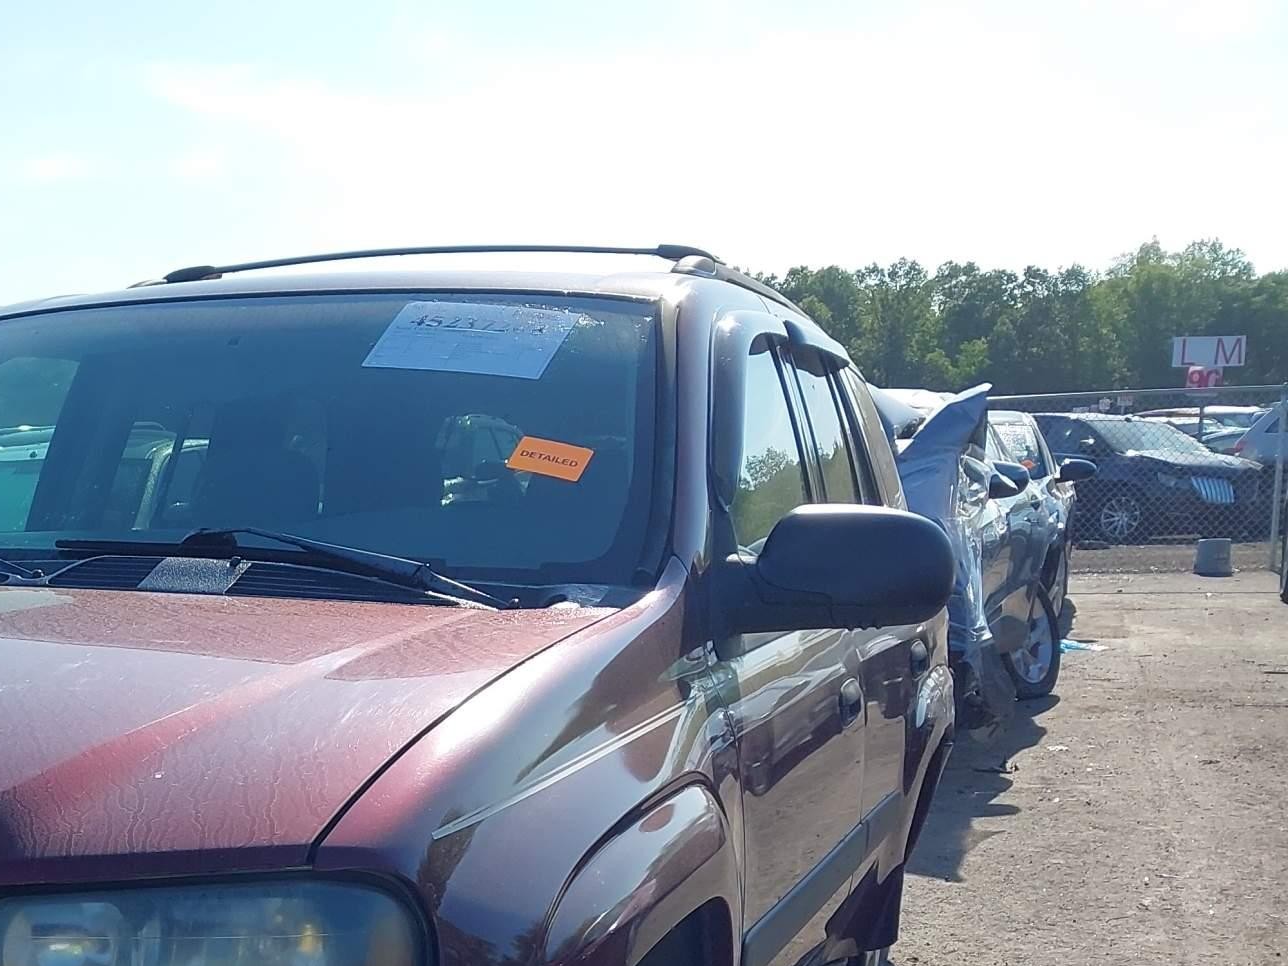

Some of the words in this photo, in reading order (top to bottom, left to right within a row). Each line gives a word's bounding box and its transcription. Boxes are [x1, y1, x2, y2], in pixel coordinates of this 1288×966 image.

[1180, 338, 1195, 366] L
[1214, 337, 1243, 365] M
[520, 449, 578, 467] DETAILED
